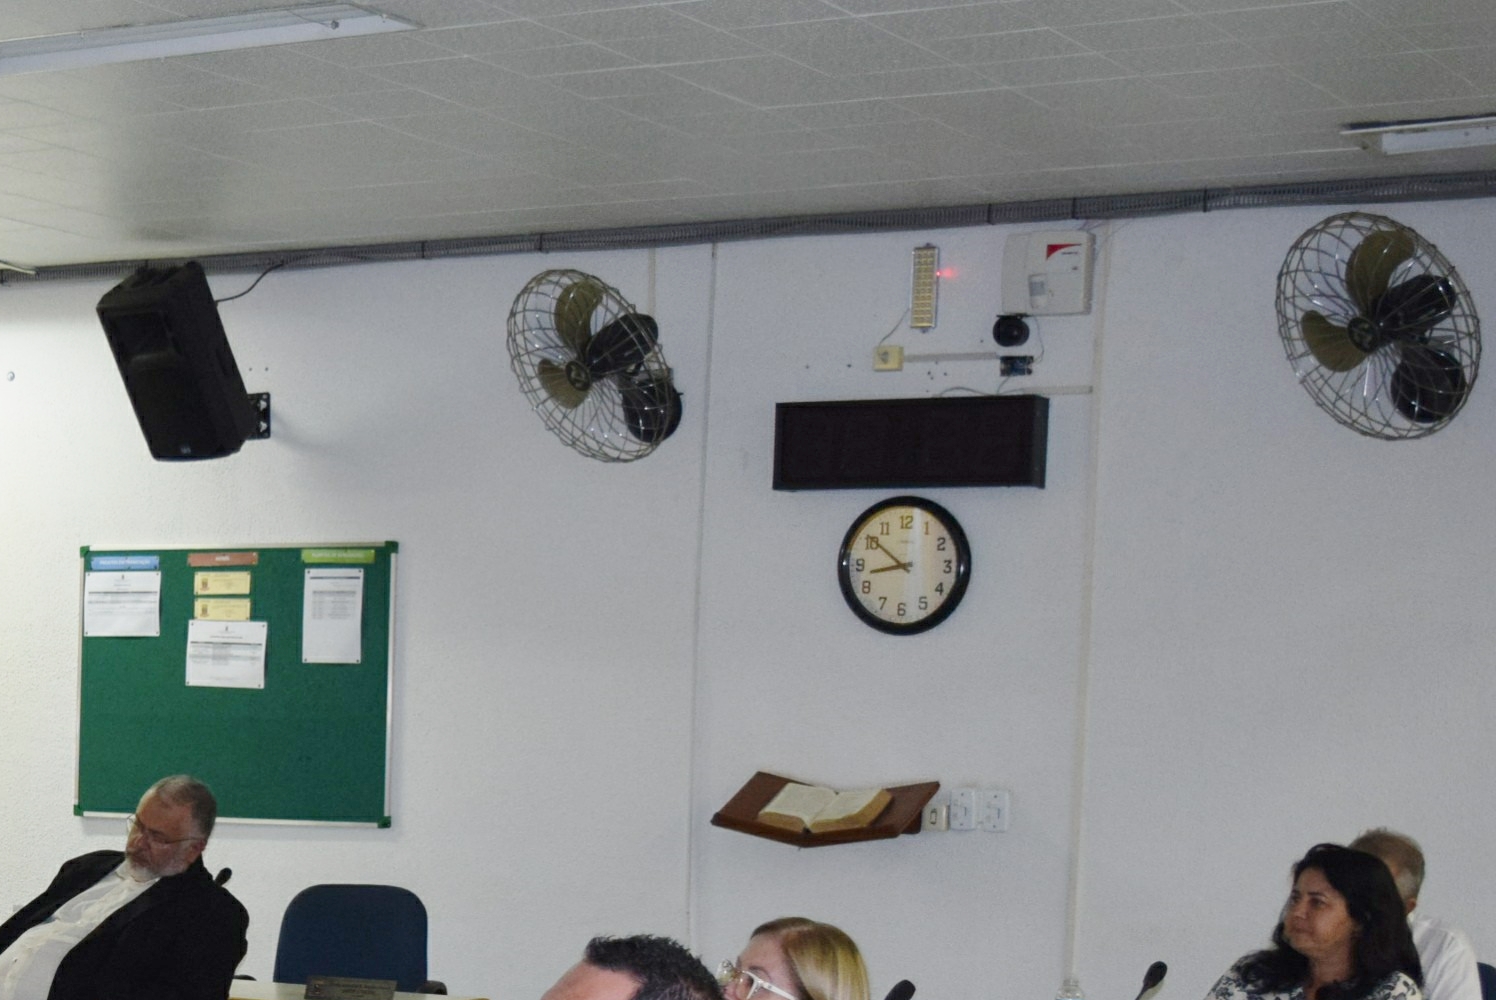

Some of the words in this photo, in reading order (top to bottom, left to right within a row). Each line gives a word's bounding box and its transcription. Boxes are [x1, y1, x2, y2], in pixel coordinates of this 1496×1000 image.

[879, 522, 890, 535] 11
[900, 515, 914, 529] 12
[924, 522, 930, 535] 1
[937, 537, 946, 551] 2
[856, 558, 865, 572] 9
[943, 560, 952, 574] 3
[862, 580, 871, 594] 8
[935, 582, 944, 595] 4
[879, 596, 887, 610] 7
[897, 602, 906, 616] 6
[919, 596, 928, 610] 5
